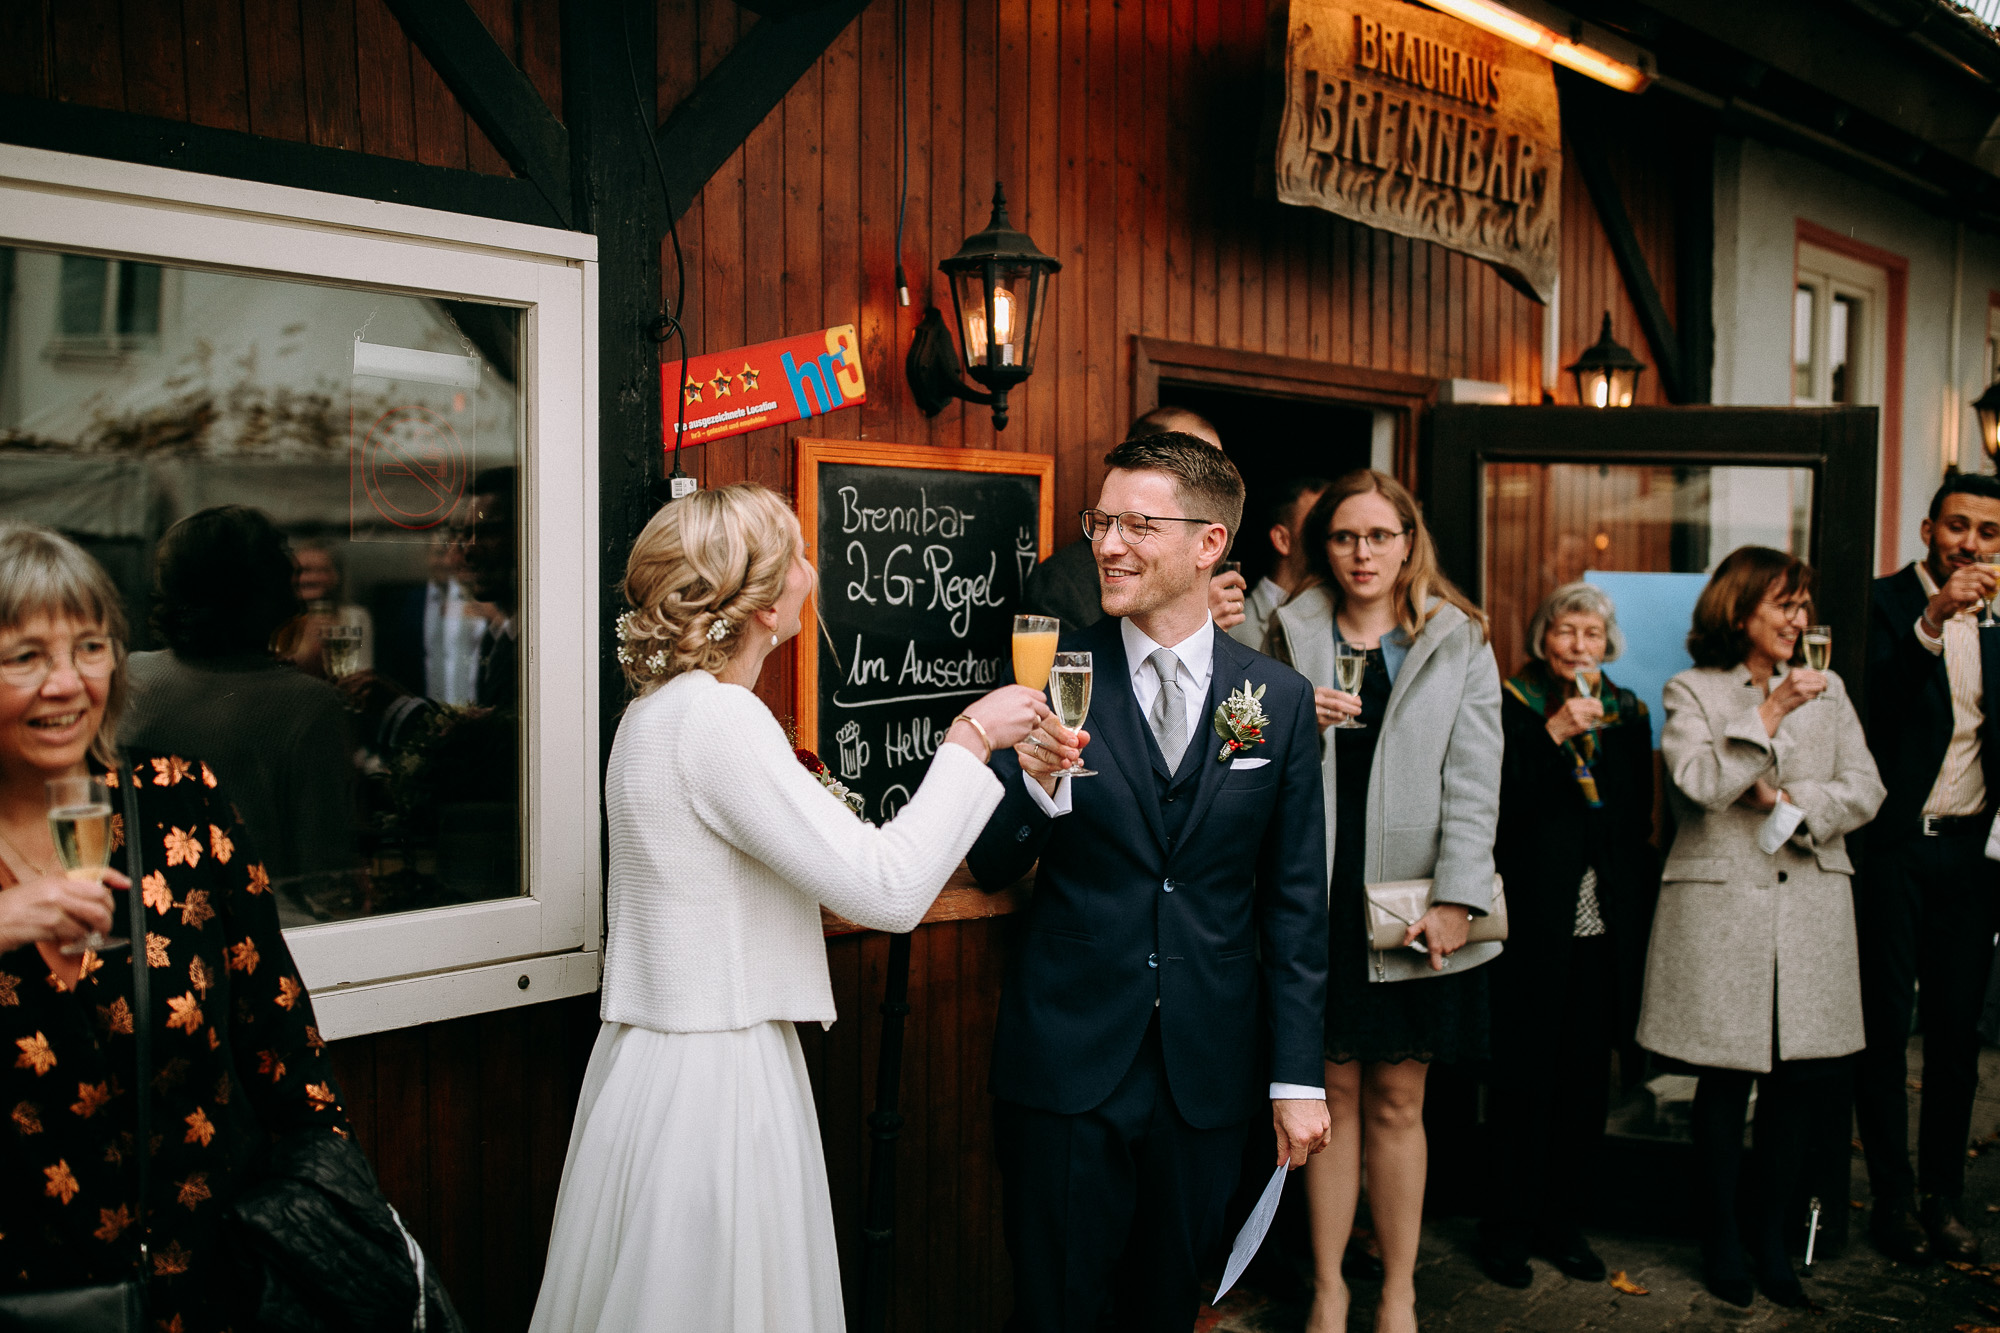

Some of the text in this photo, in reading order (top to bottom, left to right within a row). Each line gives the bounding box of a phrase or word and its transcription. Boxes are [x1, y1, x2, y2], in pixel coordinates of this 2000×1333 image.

[1356, 16, 1501, 112] BRAUHAUS
[1306, 70, 1538, 207] BRENNBAR
[674, 401, 778, 433] De ausgezeichnete Location
[780, 324, 866, 419] hr3
[838, 486, 975, 538] Brennbar
[847, 540, 1005, 638] 2-G-Regel
[898, 639, 1005, 687] Ausschan
